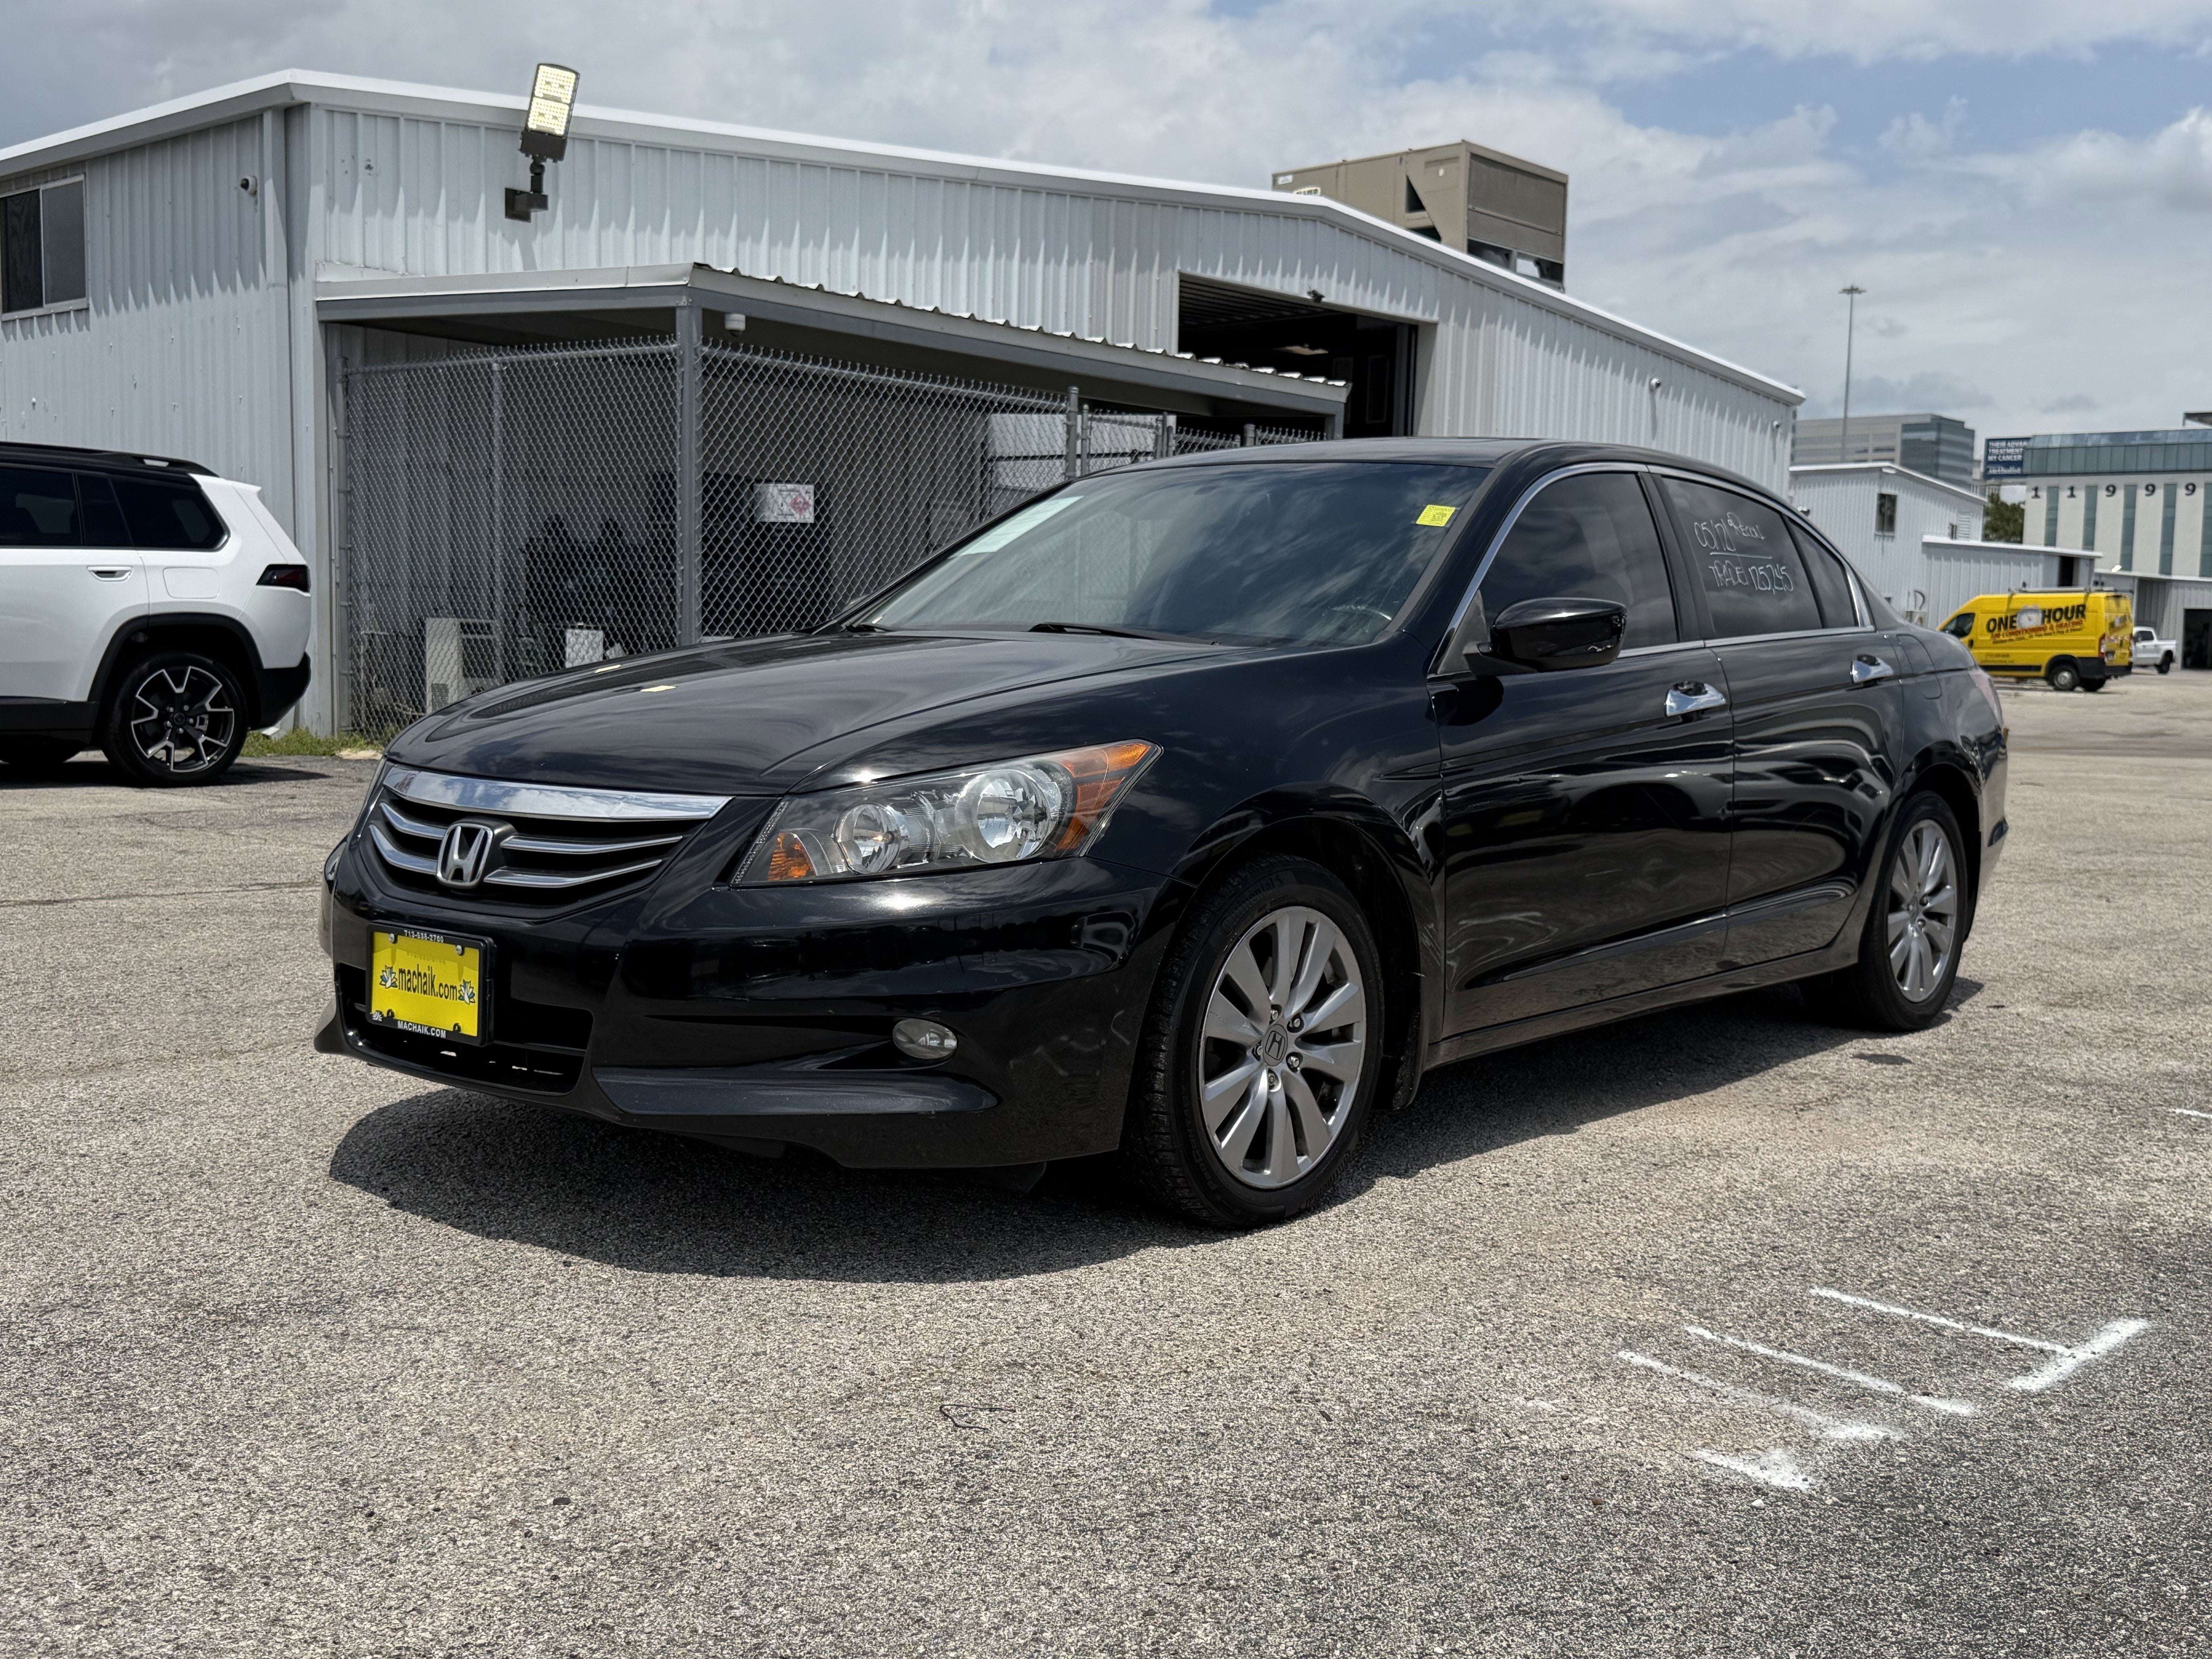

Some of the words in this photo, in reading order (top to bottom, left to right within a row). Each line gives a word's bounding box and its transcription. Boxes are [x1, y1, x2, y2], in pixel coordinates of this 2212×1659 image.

[1986, 614, 2017, 633] ONE
[2041, 604, 2087, 625] HOUR
[398, 963, 457, 1001] machaik.com
[398, 1020, 446, 1038] MACHAIK.COM
